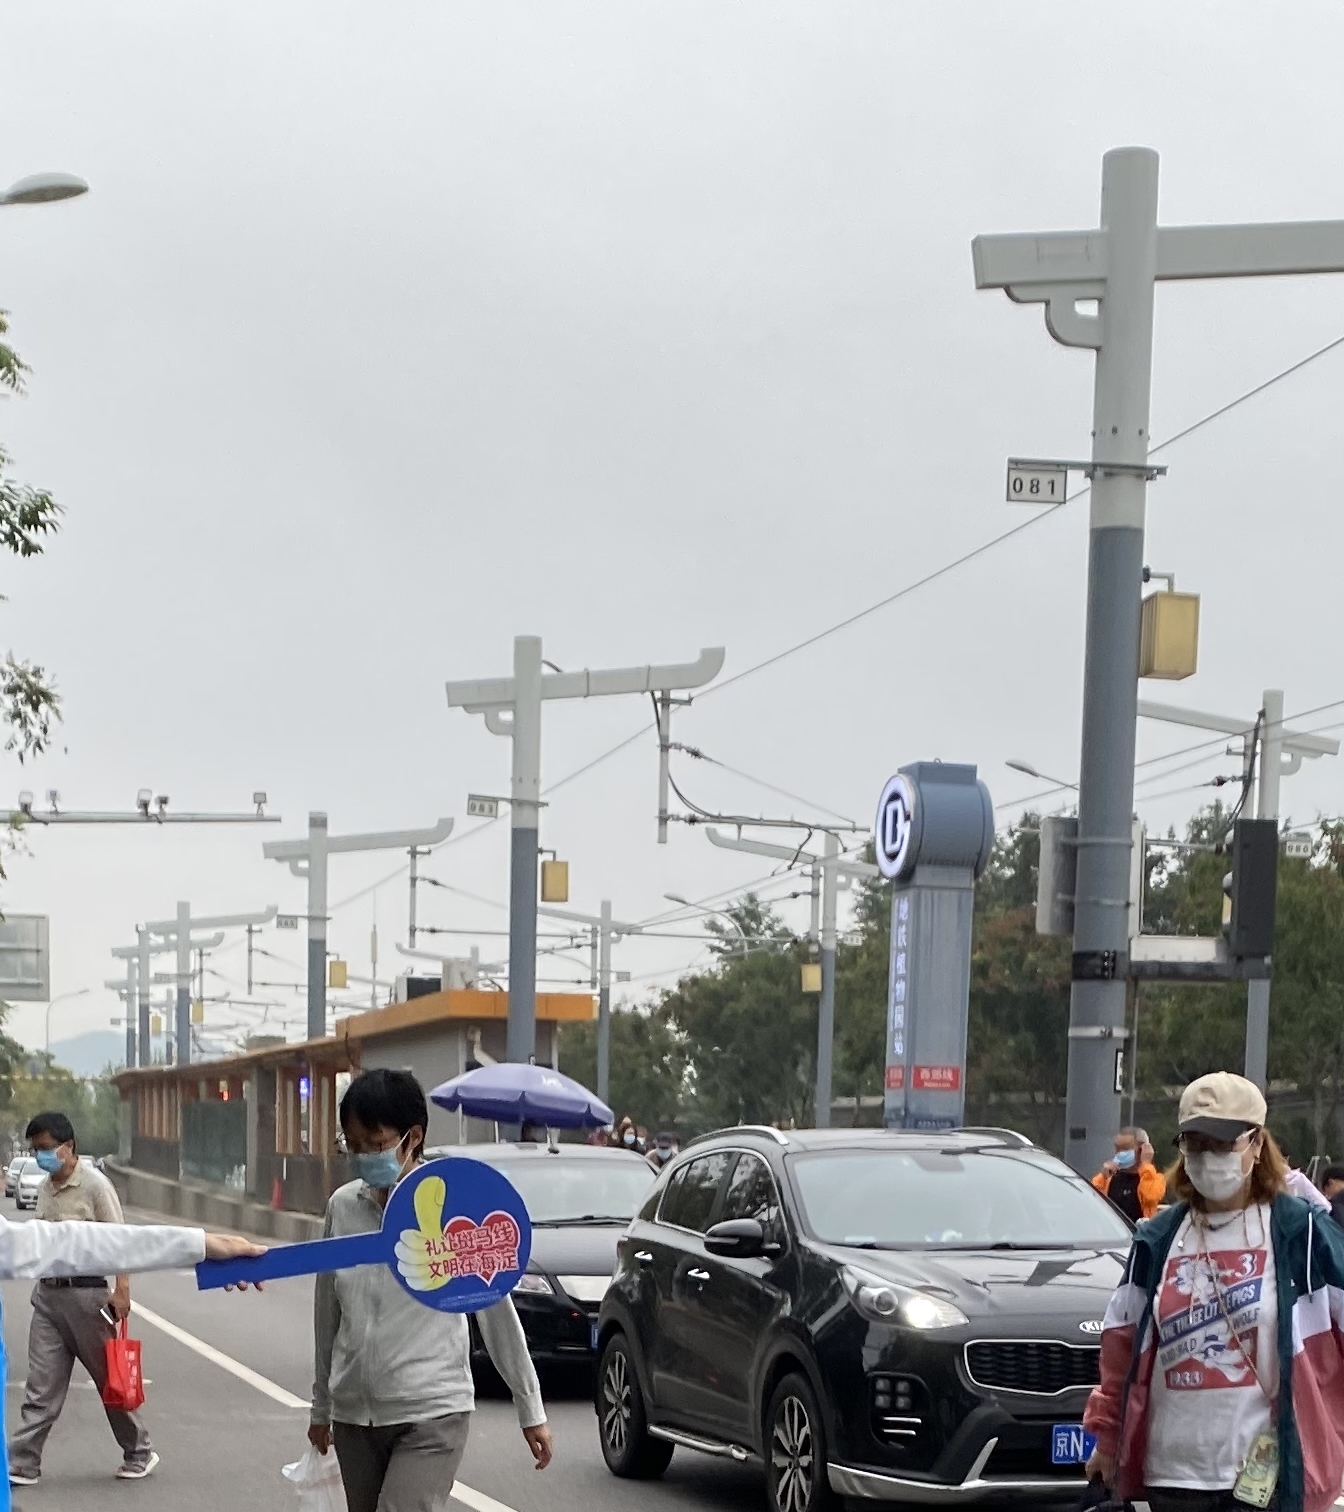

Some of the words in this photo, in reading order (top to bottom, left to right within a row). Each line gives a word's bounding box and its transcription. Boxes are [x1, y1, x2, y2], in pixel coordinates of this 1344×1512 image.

[1012, 477, 1056, 496] 081
[424, 1220, 516, 1257] 礼让斑马线
[428, 1247, 518, 1279] 文明在海淀
[1235, 1252, 1258, 1279] 3
